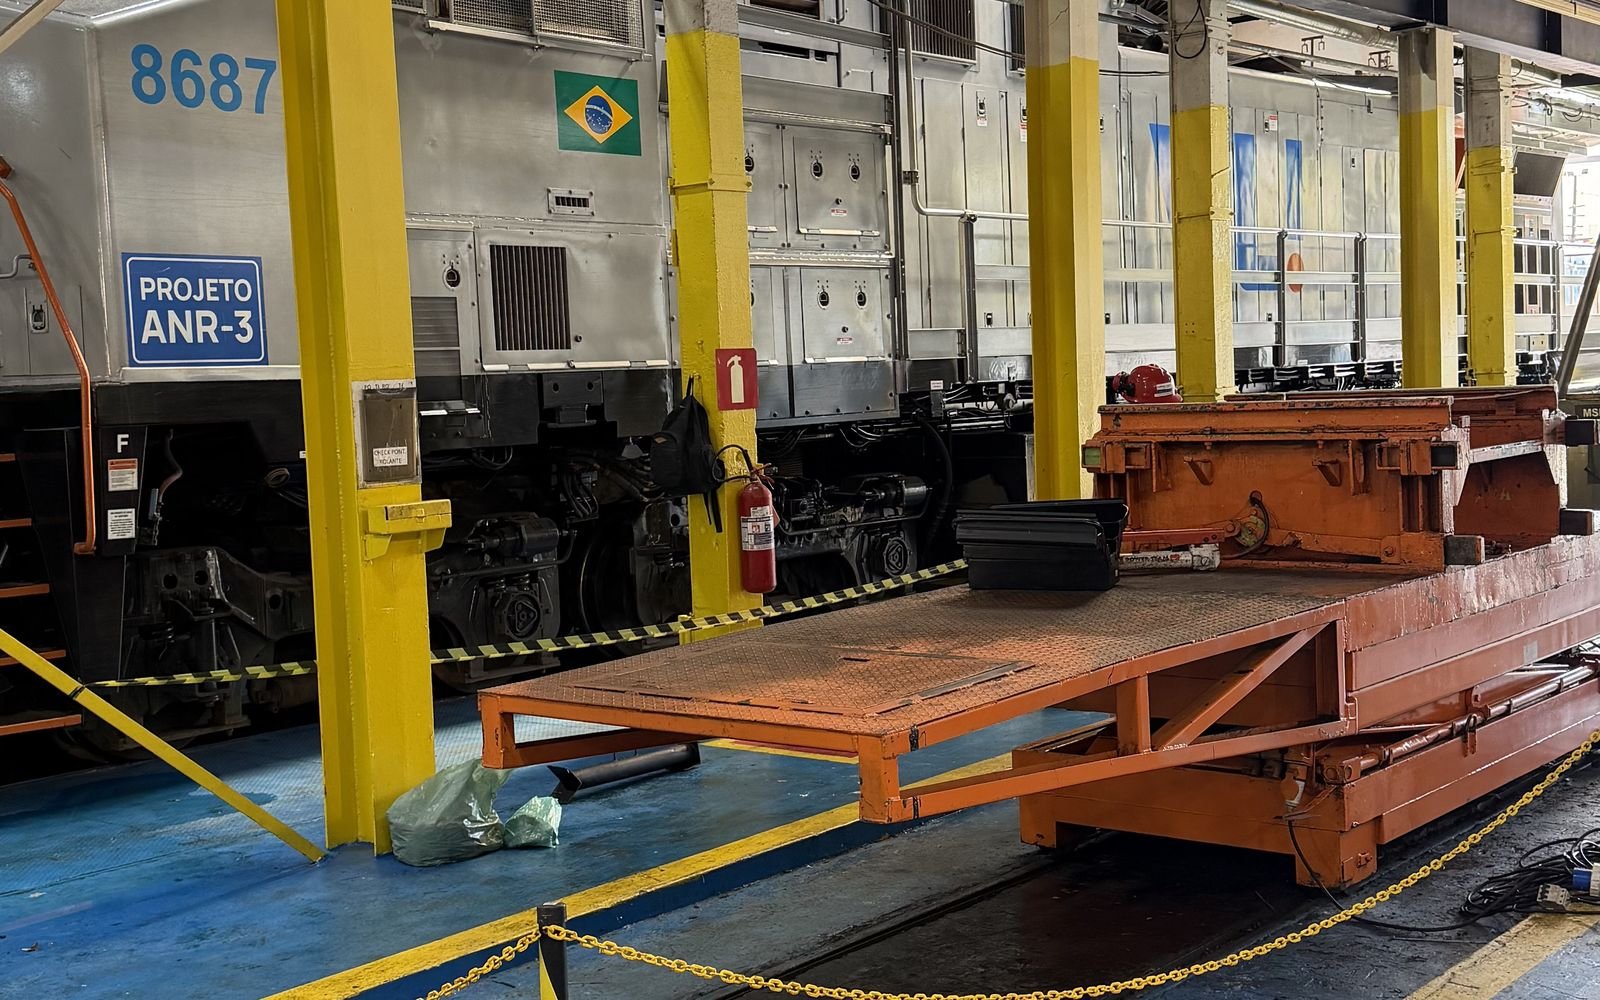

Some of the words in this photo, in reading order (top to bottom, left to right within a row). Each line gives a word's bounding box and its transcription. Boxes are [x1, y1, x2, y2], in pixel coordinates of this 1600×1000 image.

[131, 44, 277, 114] 8687
[140, 277, 252, 301] PROJETO
[141, 310, 253, 343] ANR-3
[117, 434, 129, 453] F
